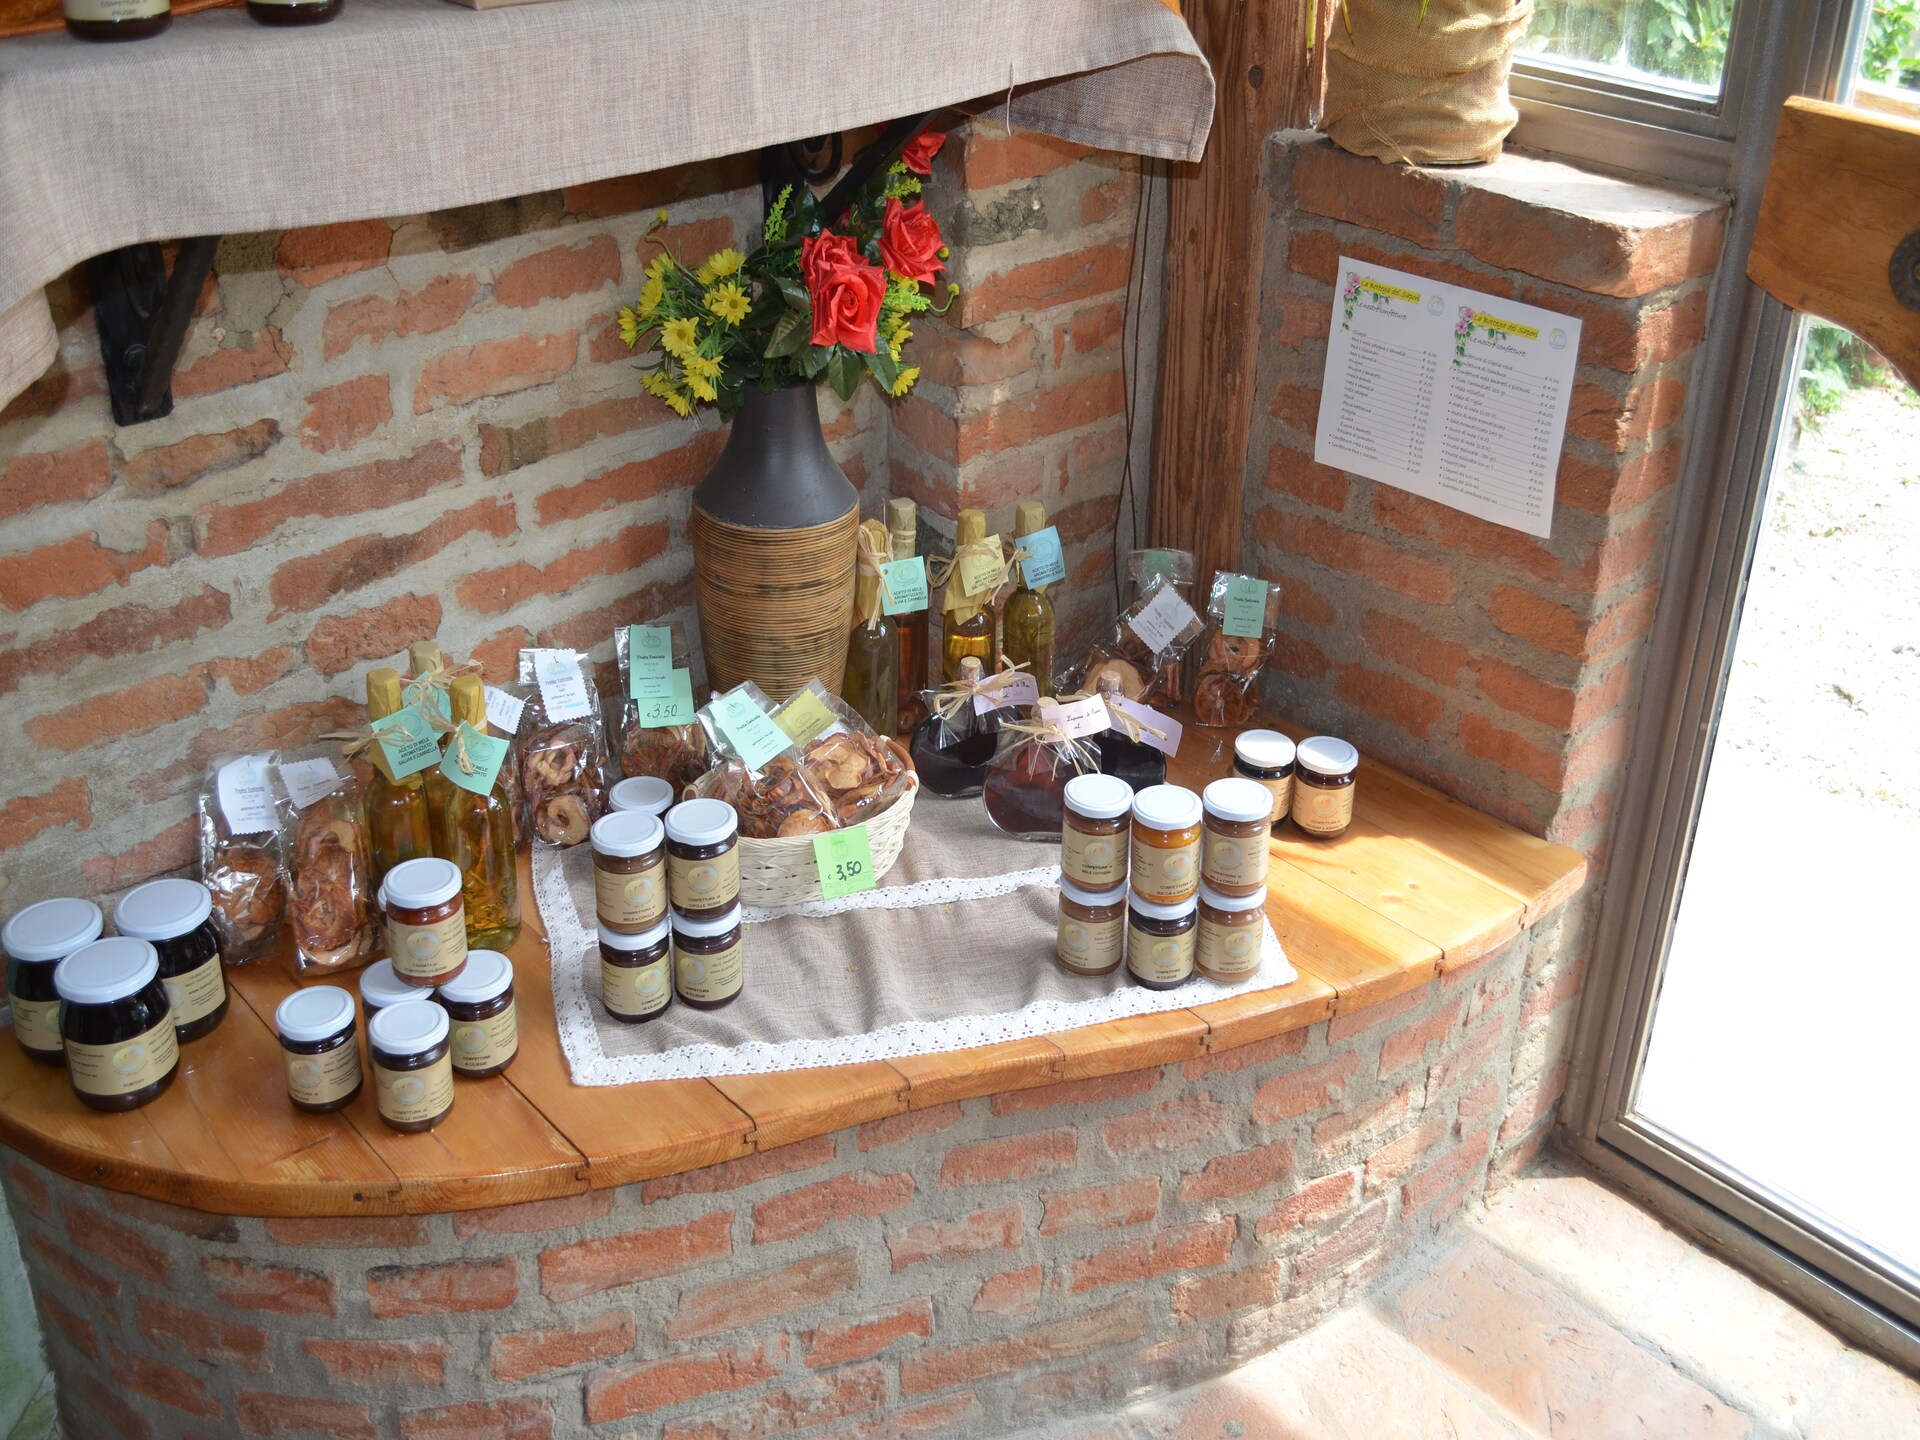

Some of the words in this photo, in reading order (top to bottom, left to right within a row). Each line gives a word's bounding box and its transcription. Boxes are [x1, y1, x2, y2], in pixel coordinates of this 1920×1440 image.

[1360, 279, 1368, 287] La
[1369, 281, 1391, 296] Bottega
[1391, 286, 1400, 295] dei
[1401, 290, 1420, 304] Sapori
[1473, 314, 1483, 322] La
[1483, 316, 1506, 331] Bottega
[1506, 322, 1516, 331] dei
[1517, 326, 1538, 339] Sapori
[399, 744, 413, 754] ACETO
[401, 742, 433, 758] AROMATIZZATO
[417, 747, 438, 759] CANNELLA
[836, 860, 862, 881] 3,50
